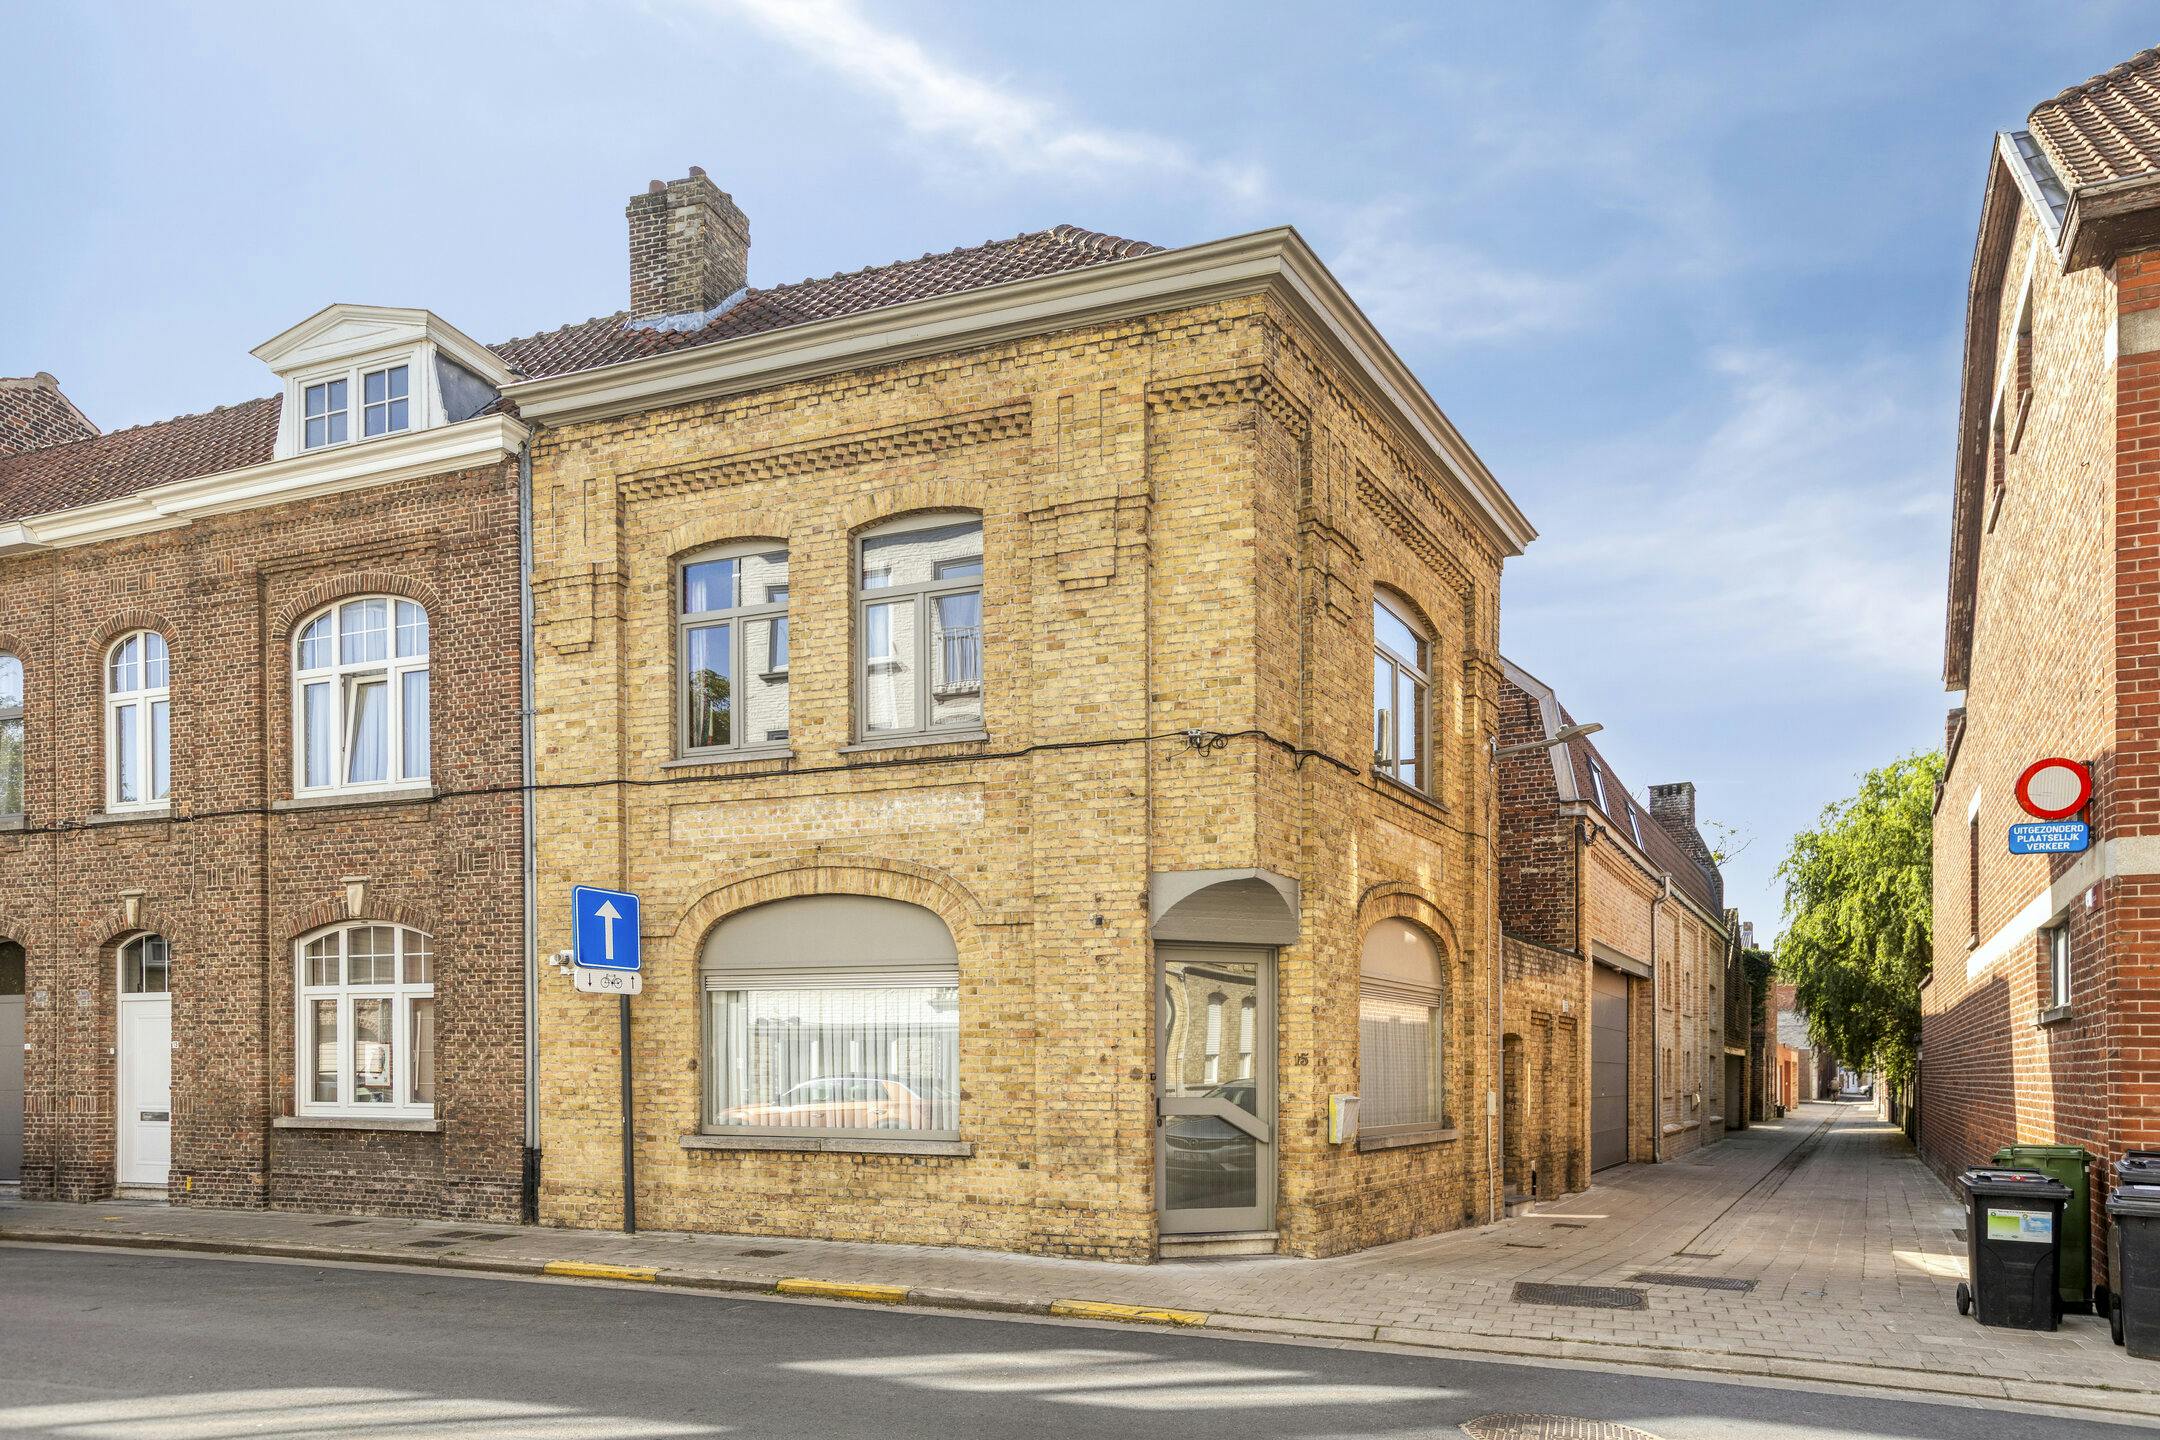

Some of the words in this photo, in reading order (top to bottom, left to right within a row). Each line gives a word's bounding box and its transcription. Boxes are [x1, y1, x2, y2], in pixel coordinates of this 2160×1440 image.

[2013, 825, 2084, 835] UITGEZONDERD
[2017, 833, 2080, 843] PLAATSELIJK
[2026, 842, 2070, 851] VERKEER
[1295, 1052, 1309, 1066] 15
